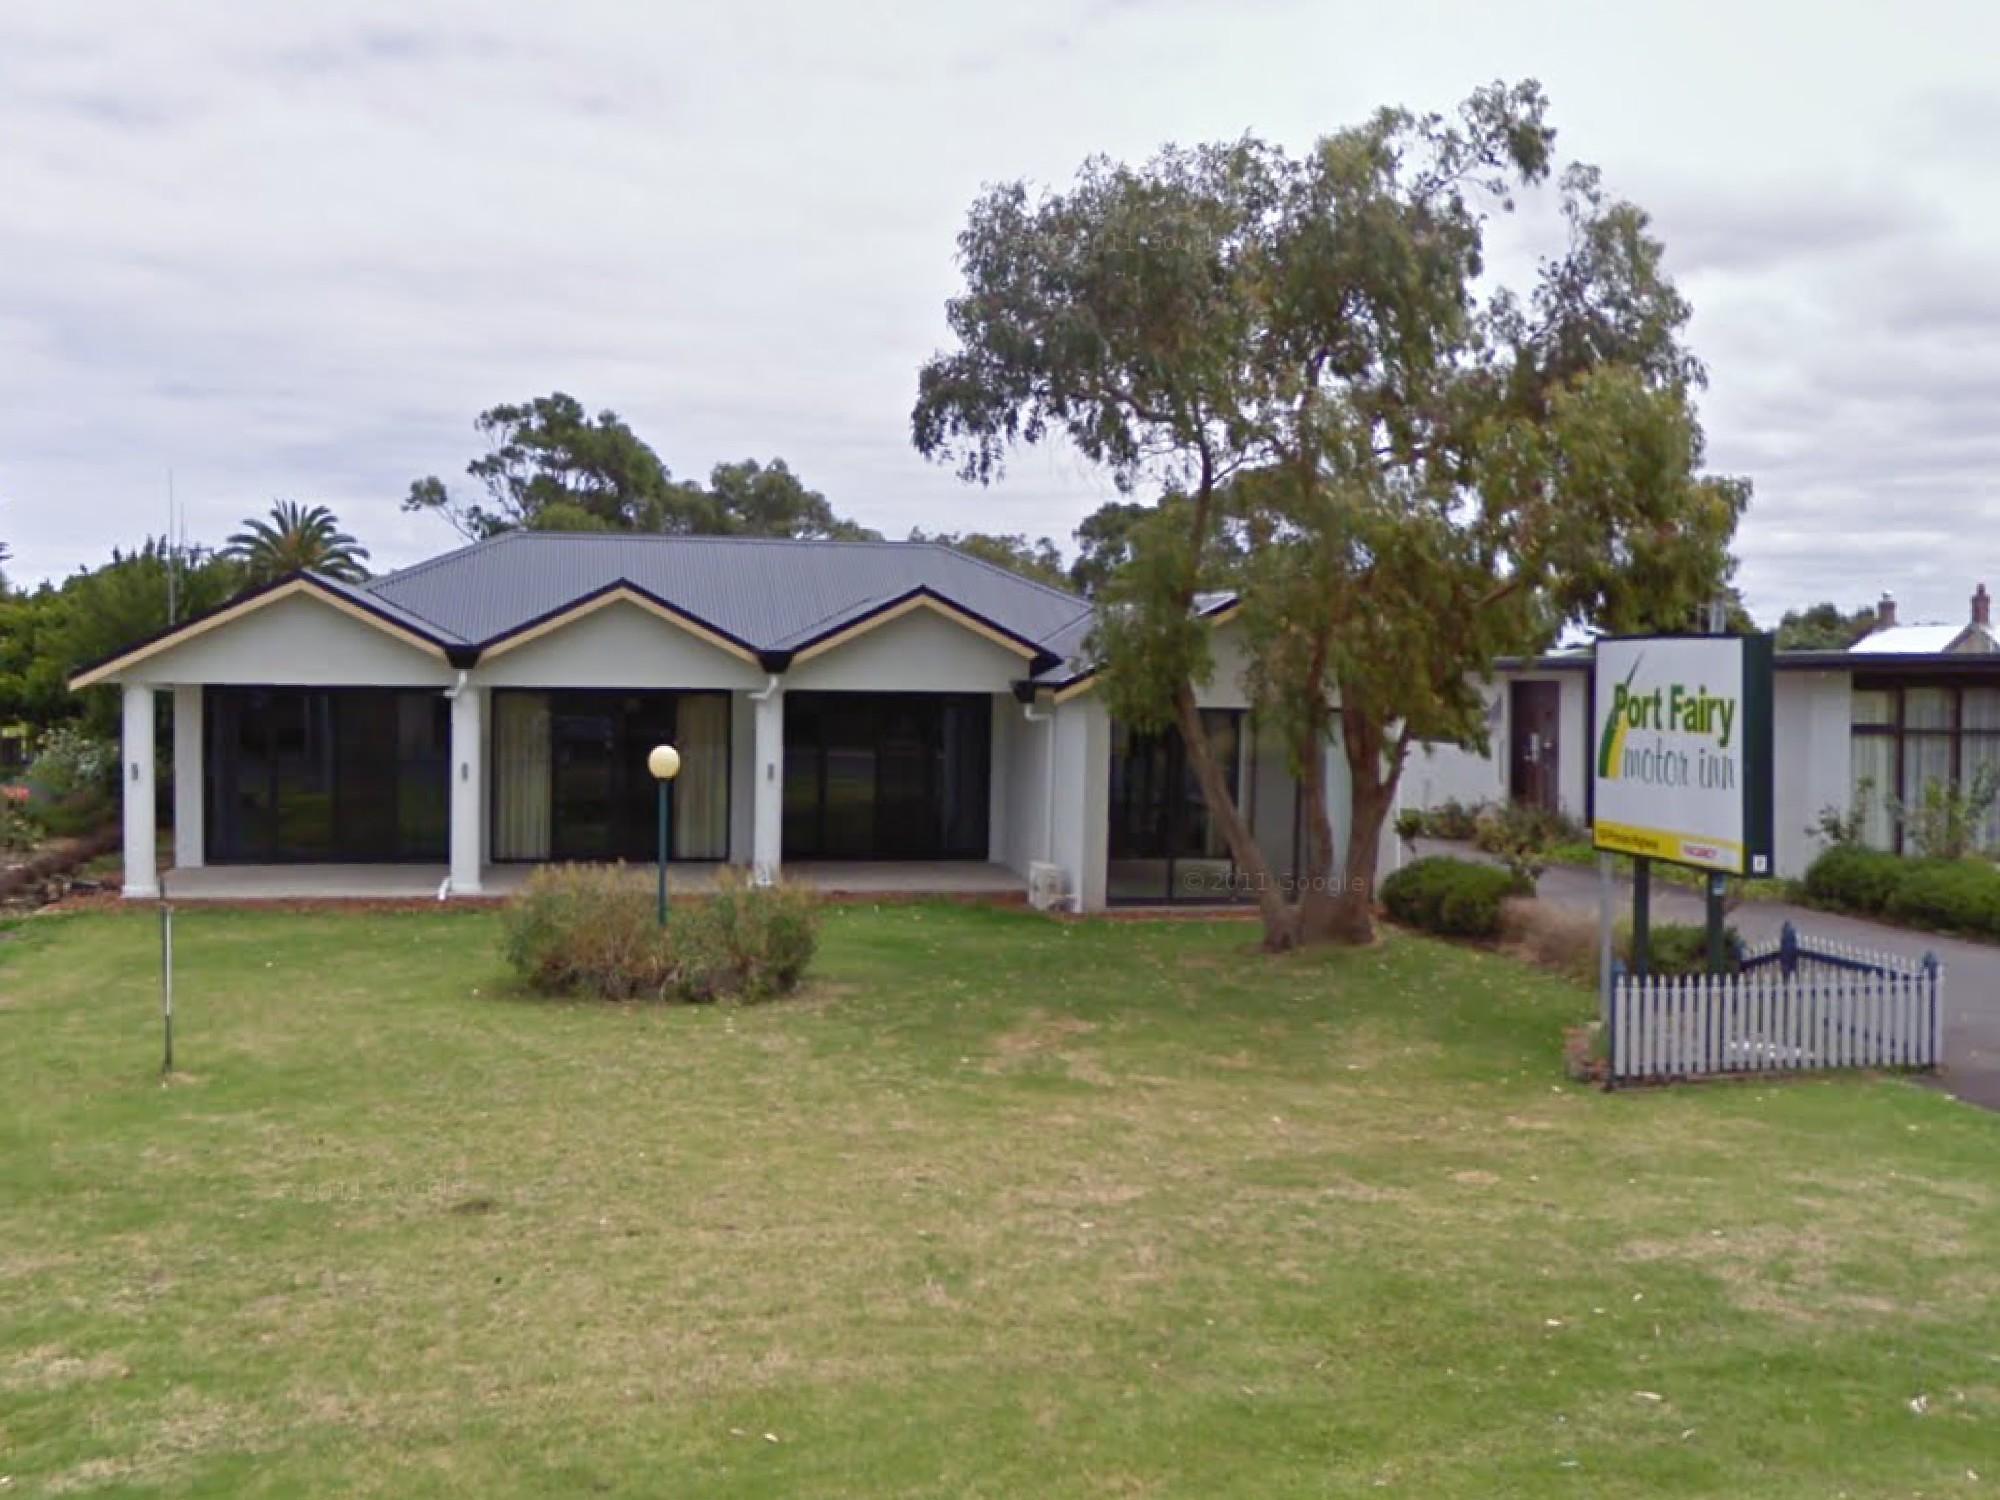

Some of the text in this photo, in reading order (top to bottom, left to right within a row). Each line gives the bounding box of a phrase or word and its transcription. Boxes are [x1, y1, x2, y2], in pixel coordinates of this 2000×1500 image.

[1614, 683, 1735, 748] Port Fairy
[1623, 737, 1735, 790] motor inn
